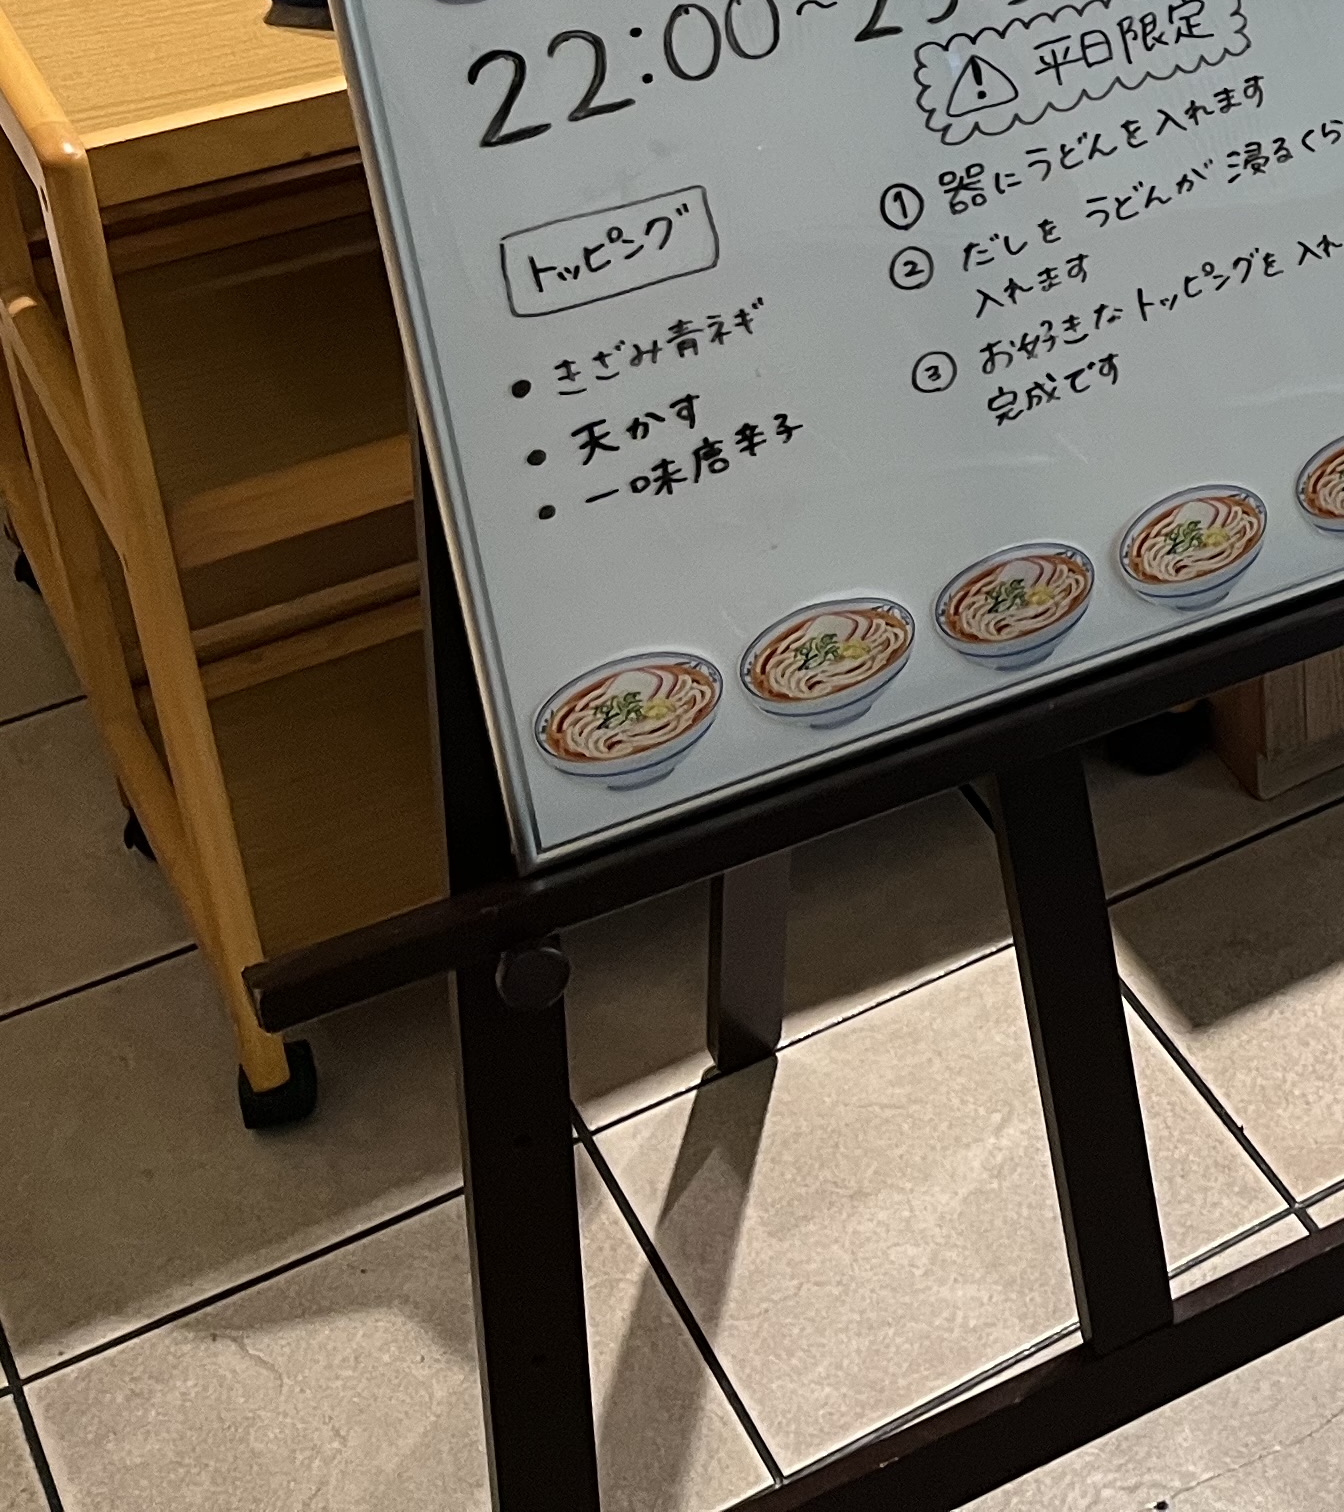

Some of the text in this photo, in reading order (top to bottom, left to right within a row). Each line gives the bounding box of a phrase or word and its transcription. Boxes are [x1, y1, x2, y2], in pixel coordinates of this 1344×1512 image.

[528, 203, 689, 292] トッピング
[976, 254, 1089, 317] 入れます
[554, 297, 764, 395] きざみ青ネギ
[571, 394, 700, 465] 天かす
[987, 353, 1119, 426] 完成です
[585, 413, 803, 503] 一味唐辛子
